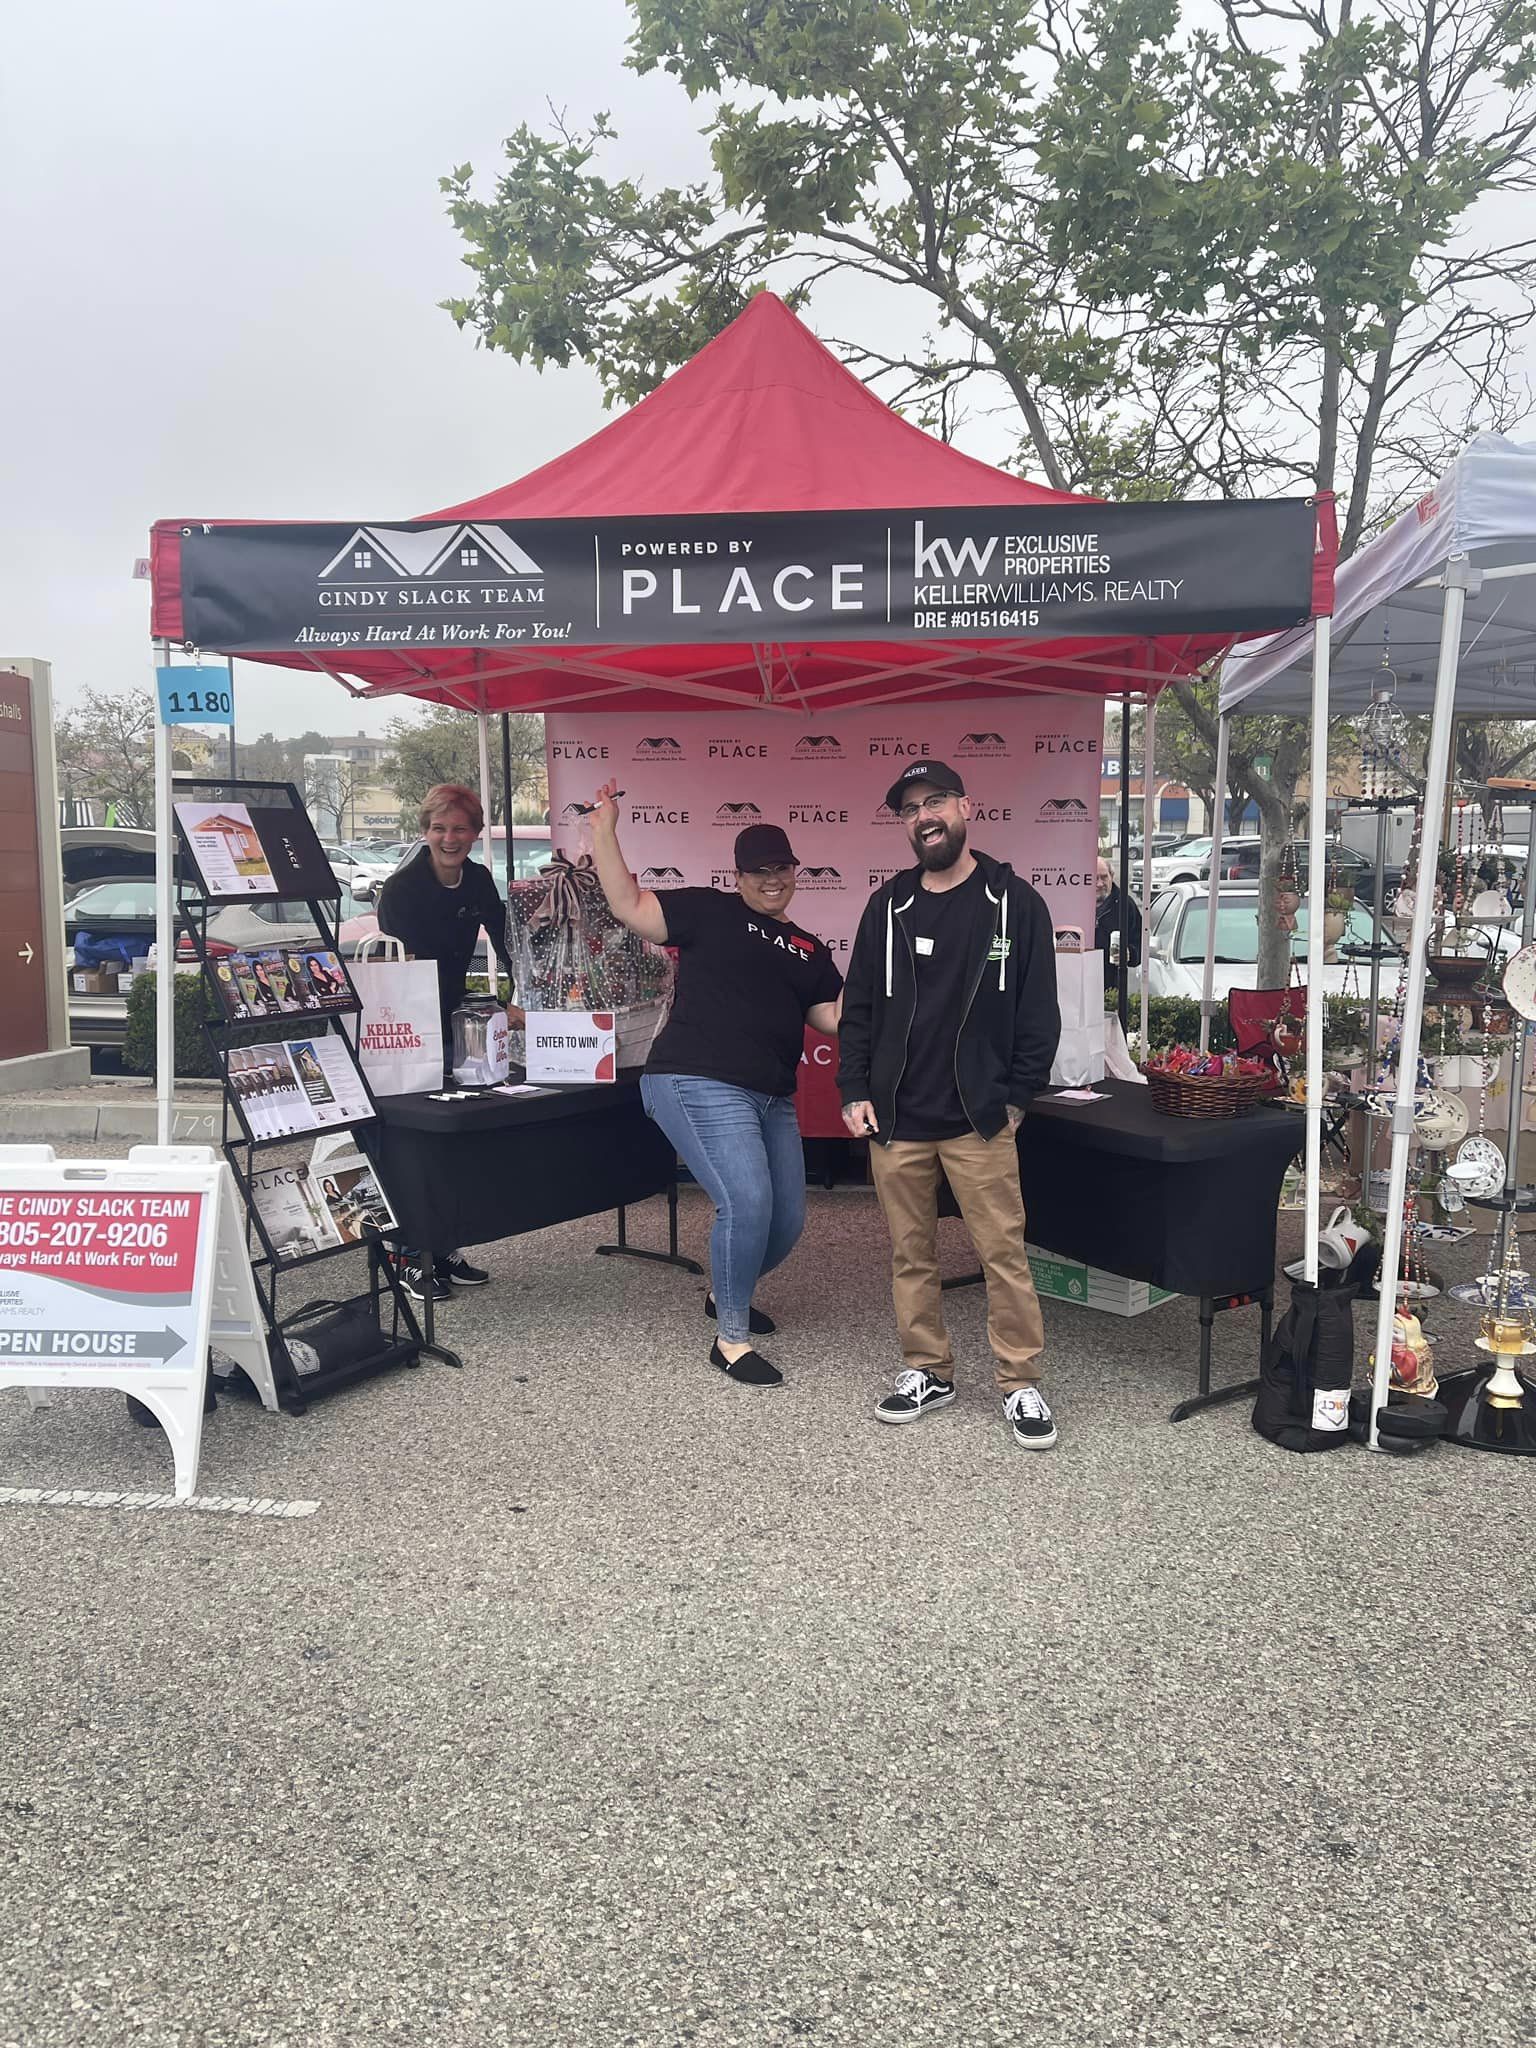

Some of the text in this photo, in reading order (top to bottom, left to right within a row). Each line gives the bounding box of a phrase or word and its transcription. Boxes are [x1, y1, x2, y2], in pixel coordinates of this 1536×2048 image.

[622, 541, 752, 556] POWERED BY
[914, 520, 998, 578] kw
[1004, 534, 1098, 554] EXCLUSIVE
[1004, 556, 1110, 576] PROPERTIES
[318, 588, 545, 606] CINDY SLACK TEAM
[622, 564, 864, 614] PLACE
[1104, 579, 1184, 602] REALTY
[914, 610, 1038, 628] DRE #01516415
[294, 622, 572, 646] Always Hard At Work For You!
[168, 692, 230, 714] 1180
[553, 747, 609, 758] PLACE
[709, 746, 768, 758] PLACE
[870, 744, 930, 756] PLACE
[1035, 740, 1096, 753] PLACE
[632, 812, 689, 823] PLACE
[789, 811, 848, 823] PLACE
[282, 837, 300, 869] PLACE
[1032, 874, 1092, 886] PLACE
[748, 922, 808, 962] PLACE
[366, 1023, 413, 1036] KELLER
[360, 1035, 421, 1050] WILLIAMS
[536, 1036, 598, 1048] ENTER TO WIN!
[18, 1198, 72, 1216] CINDY
[76, 1199, 135, 1217] SLACK
[140, 1199, 190, 1217] TEAM
[30, 1252, 63, 1265] Hard
[66, 1253, 81, 1266] At
[84, 1252, 119, 1266] Work
[122, 1253, 145, 1266] For
[150, 1253, 178, 1267] You!
[52, 1333, 136, 1354] HOUSE
